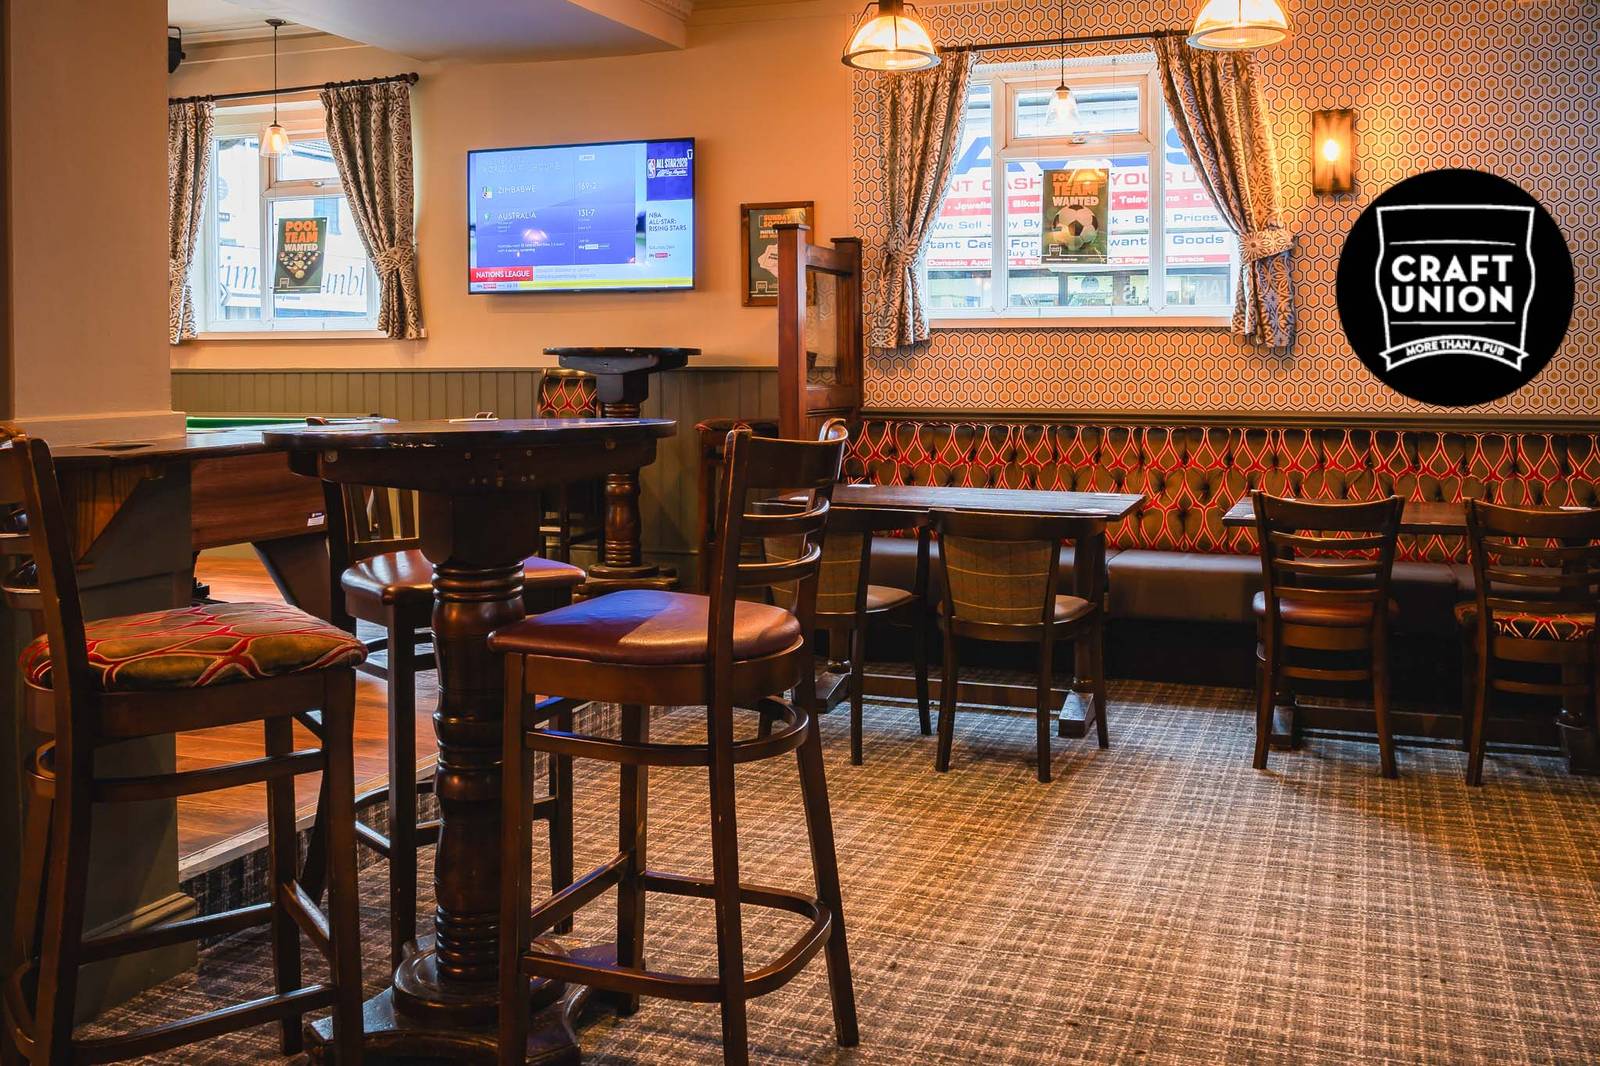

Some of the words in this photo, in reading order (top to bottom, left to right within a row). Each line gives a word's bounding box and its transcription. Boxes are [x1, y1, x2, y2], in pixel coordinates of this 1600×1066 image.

[1053, 181, 1099, 196] TEAM
[1052, 196, 1099, 206] WANTED
[498, 210, 537, 220] AUSTRALIA
[1173, 213, 1218, 222] Prices
[285, 220, 318, 232] POOL
[285, 231, 318, 243] TEAM
[967, 239, 992, 249] Cas
[1173, 234, 1225, 245] Goods
[284, 243, 318, 252] WANTED
[475, 271, 505, 279] NATIONS
[505, 270, 531, 278] LEAGUE
